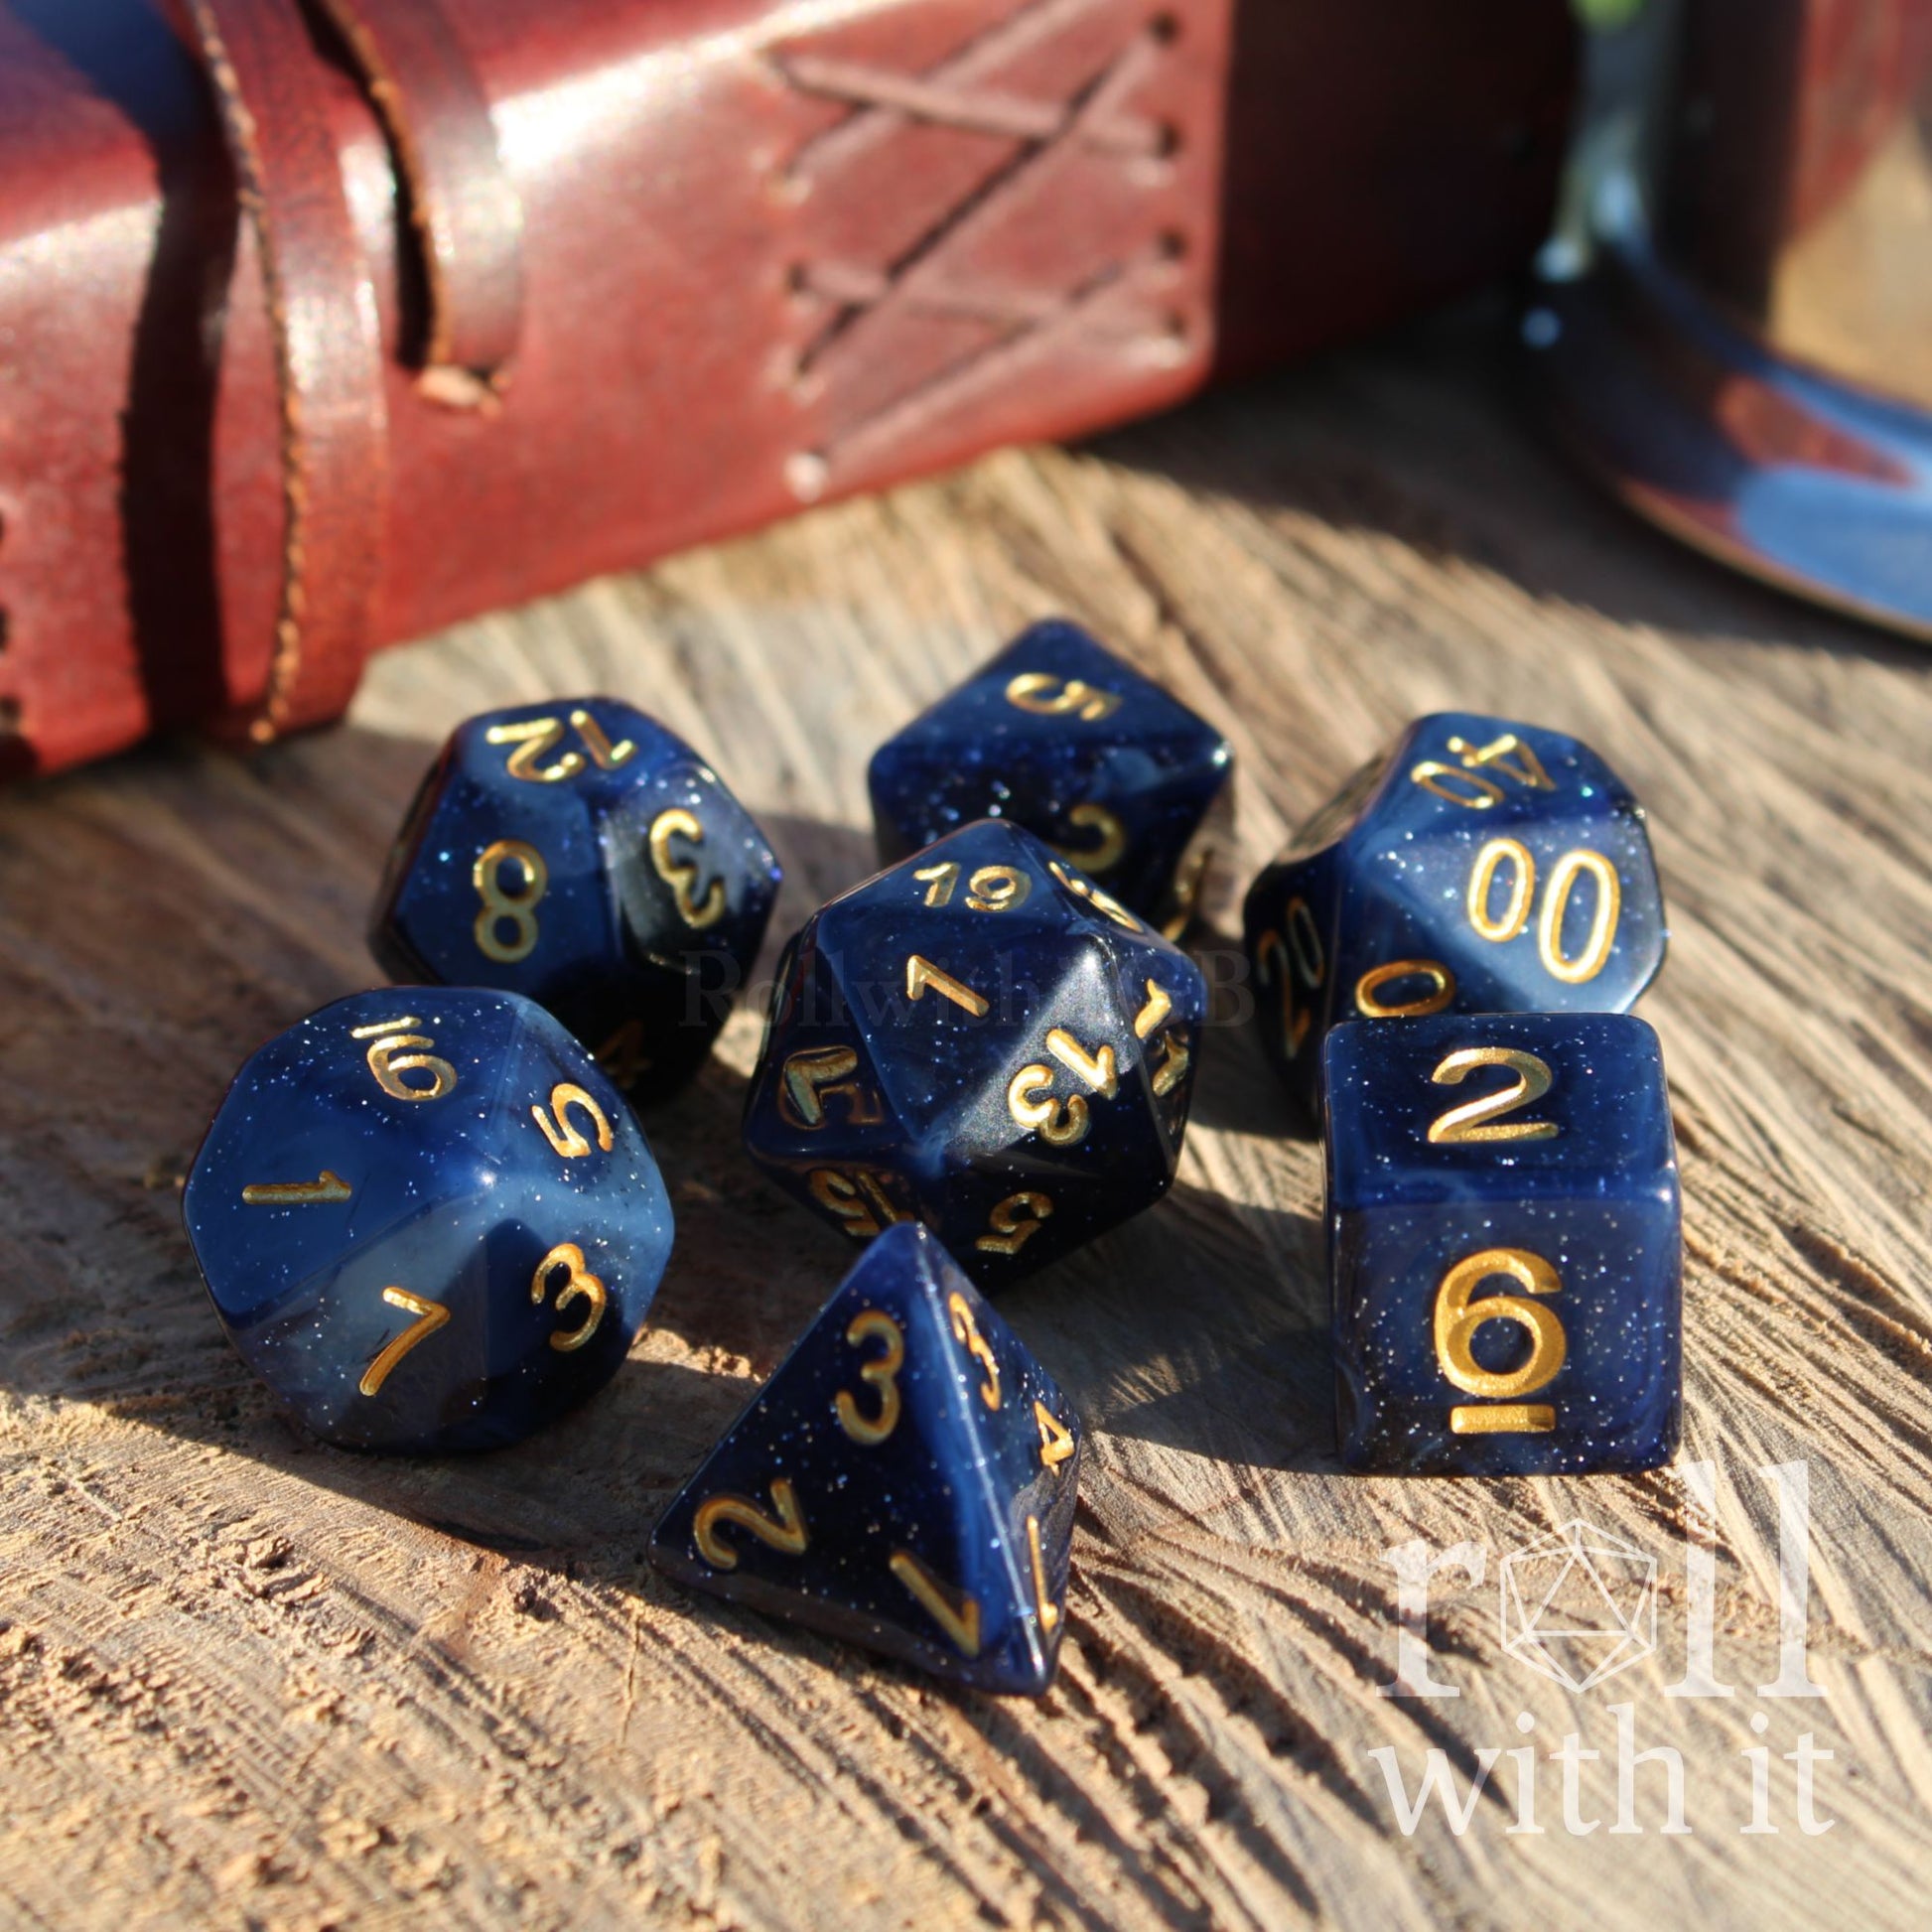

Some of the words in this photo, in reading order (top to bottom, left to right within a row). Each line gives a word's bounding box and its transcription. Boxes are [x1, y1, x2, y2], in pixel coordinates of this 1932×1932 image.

[485, 709, 637, 782] 12
[1005, 671, 1122, 721] 5
[1411, 733, 1557, 810] 40
[473, 839, 547, 963] 8
[649, 808, 726, 929] 3
[913, 861, 1033, 913] 19
[1467, 838, 1621, 984] 00
[906, 954, 990, 1018] 1
[531, 1082, 615, 1159] 5
[1007, 1028, 1117, 1147] 13
[1427, 1045, 1559, 1144] 2
[241, 1170, 352, 1205] 1
[975, 1191, 1054, 1255] 5
[358, 1286, 452, 1398] 7
[531, 1242, 607, 1352] 3
[1434, 1247, 1567, 1434] 6
[835, 1310, 904, 1447] 3
[949, 1292, 1001, 1412] 3
[1035, 1400, 1075, 1477] 4
[694, 1477, 807, 1571] 2
[891, 1551, 980, 1656] 1
